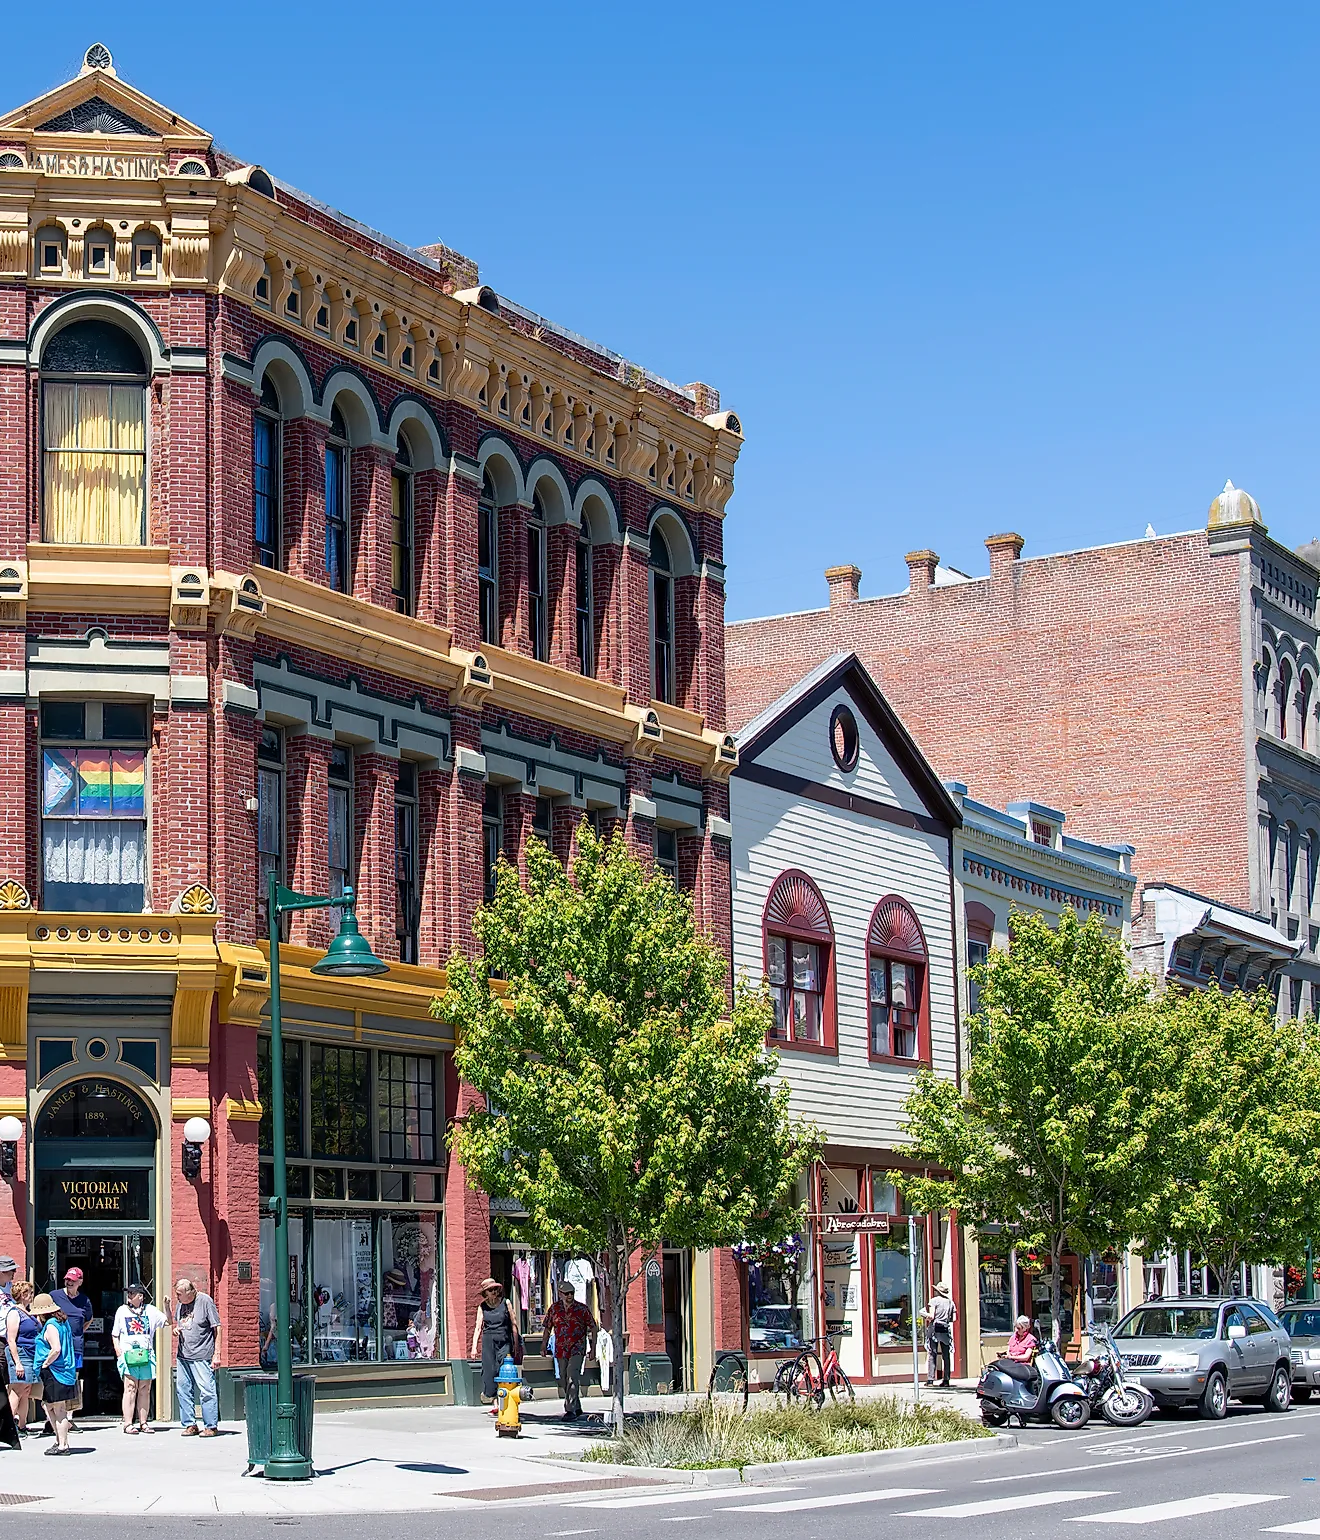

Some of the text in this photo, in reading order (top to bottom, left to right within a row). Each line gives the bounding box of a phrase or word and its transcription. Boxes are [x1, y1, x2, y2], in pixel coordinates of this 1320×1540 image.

[92, 155, 169, 179] HASTINGS
[47, 1089, 76, 1119] JAMES
[81, 1084, 89, 1093] &
[61, 1181, 129, 1194] VICTORIAN
[70, 1197, 120, 1210] SQUARE
